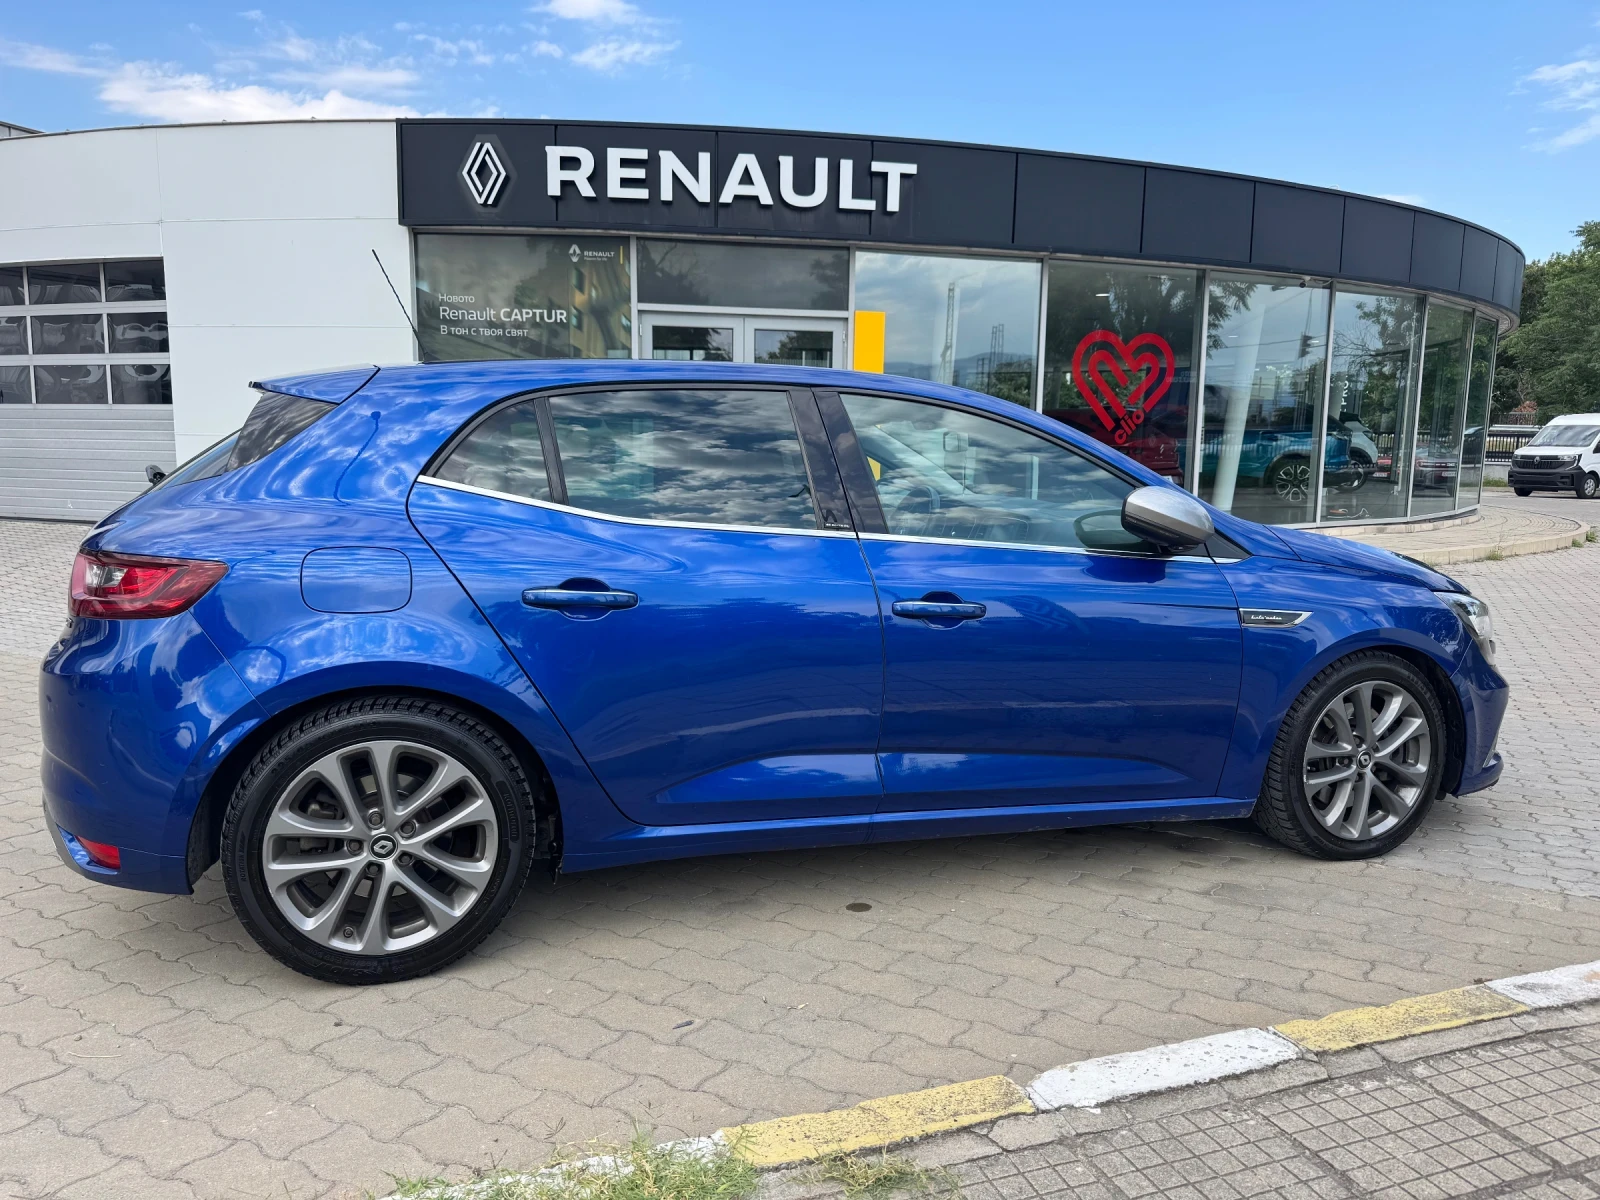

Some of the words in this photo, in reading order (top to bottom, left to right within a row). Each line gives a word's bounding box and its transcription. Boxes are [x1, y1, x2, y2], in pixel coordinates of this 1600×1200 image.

[545, 145, 917, 212] RENAULT
[583, 250, 615, 258] RENAULT
[438, 293, 475, 303] Новото
[439, 306, 497, 321] Renault
[500, 308, 567, 323] CAPTUR
[440, 325, 448, 335] В
[450, 327, 469, 336] тон
[471, 328, 477, 336] с
[479, 328, 503, 337] твоя
[505, 328, 529, 337] свят
[1115, 409, 1145, 444] clio
